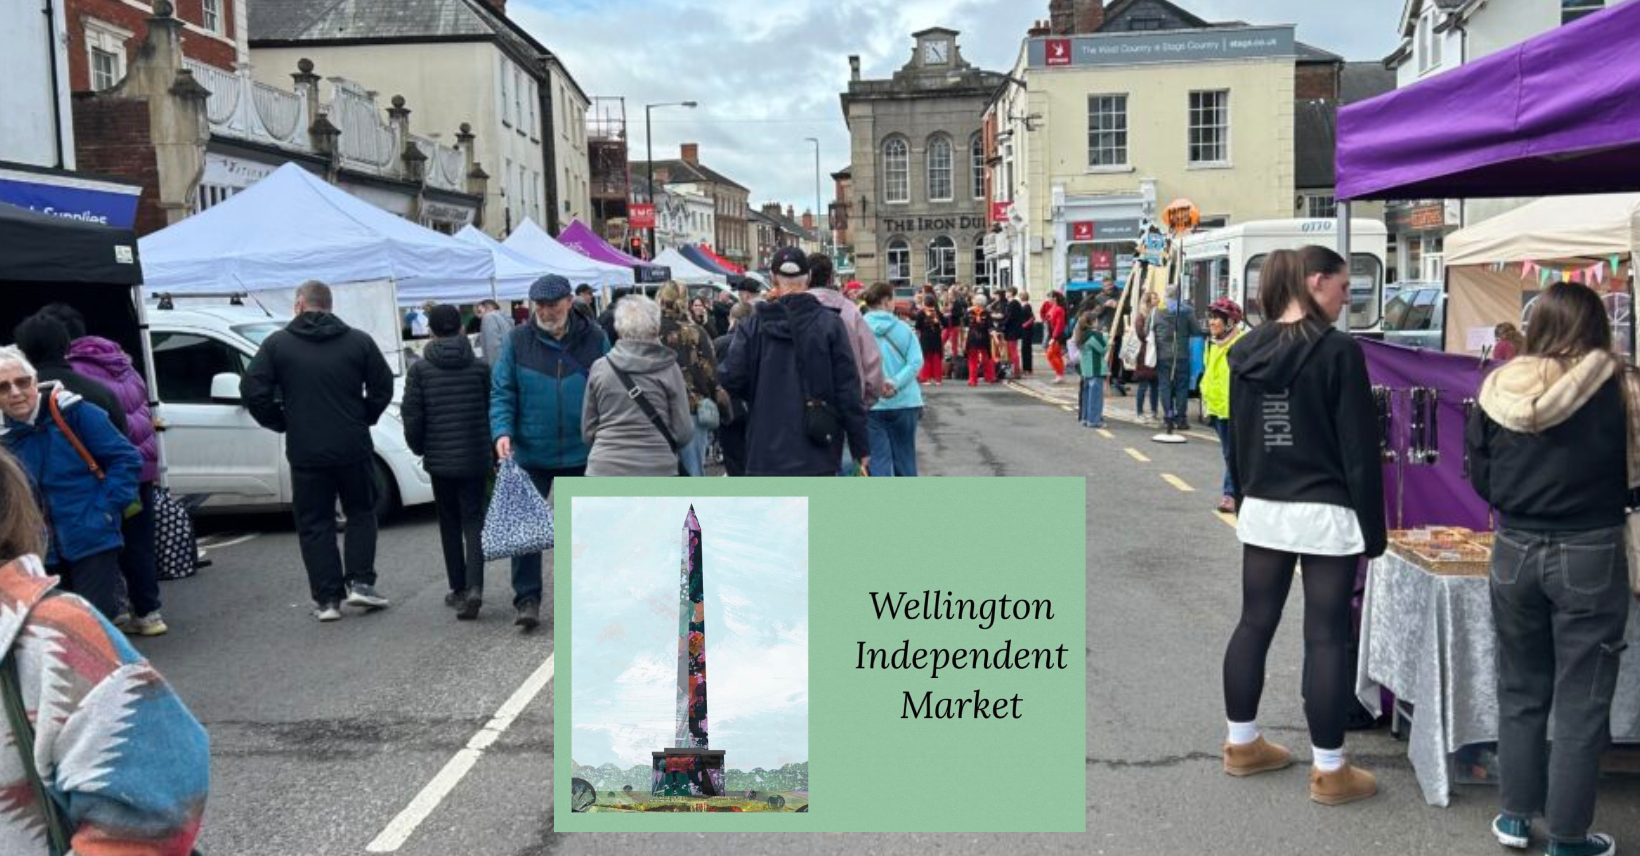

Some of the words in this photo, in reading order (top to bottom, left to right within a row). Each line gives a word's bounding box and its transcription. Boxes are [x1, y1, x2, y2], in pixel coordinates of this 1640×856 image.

[1082, 45, 1098, 55] The
[1121, 42, 1152, 54] Country
[1187, 40, 1220, 51] Country
[883, 217, 916, 232] THE
[917, 216, 955, 232] IRON
